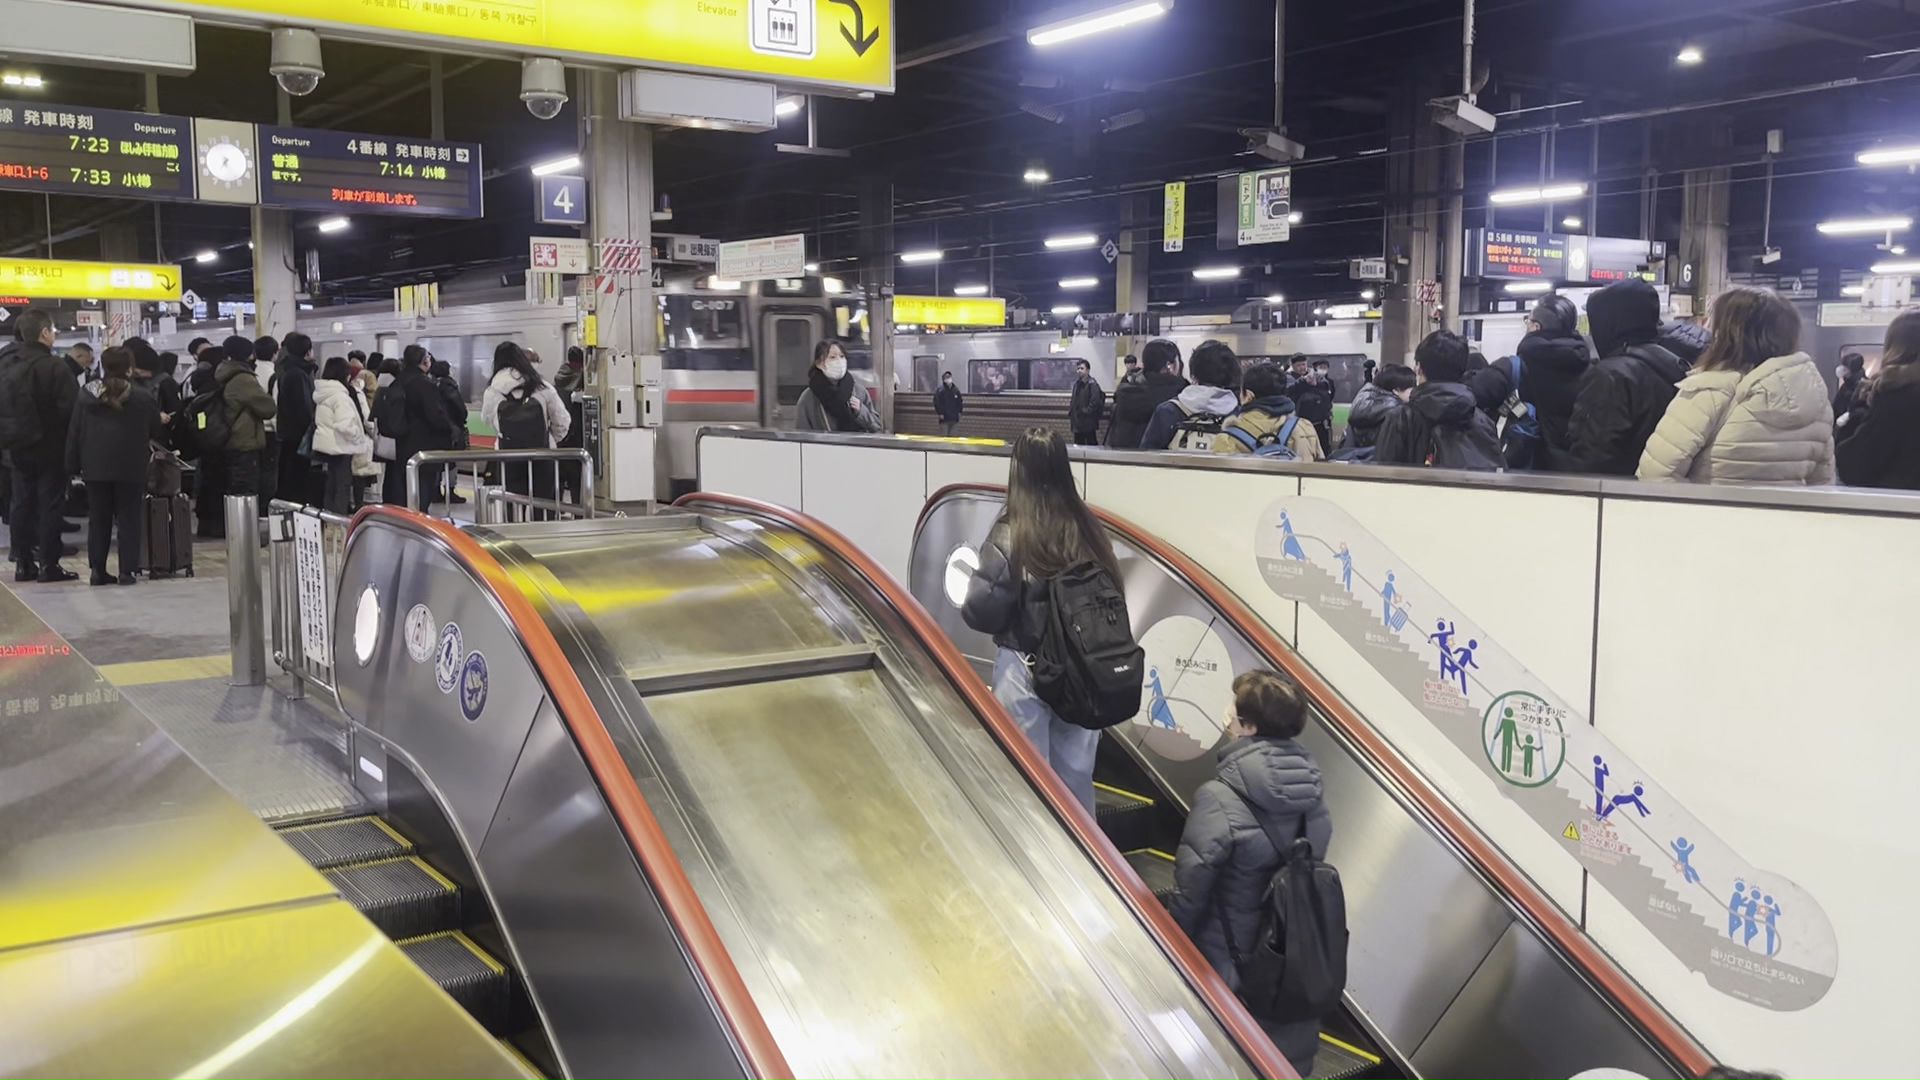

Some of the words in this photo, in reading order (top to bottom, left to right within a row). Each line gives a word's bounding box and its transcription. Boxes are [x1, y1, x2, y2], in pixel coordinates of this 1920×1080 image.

[697, 1, 737, 16] Elevator
[24, 109, 94, 131] 発車時刻
[134, 122, 177, 135] Departure
[69, 135, 109, 153] 7:23
[272, 135, 310, 147] Departure
[347, 140, 388, 156] 4番線
[396, 143, 451, 161] 発車時刻
[272, 153, 299, 169] 普通
[380, 161, 414, 177] 7:14
[70, 168, 111, 186] 7:33
[122, 172, 152, 188] 小樽
[422, 165, 446, 180] 小樽
[332, 188, 418, 206] 列車が到着します。
[553, 185, 574, 214] 4
[534, 244, 556, 252] STOP
[1105, 245, 1114, 258] 2
[14, 265, 63, 279] 東改札口
[652, 267, 662, 286] 4
[1683, 263, 1692, 282] 6
[187, 294, 194, 304] 3
[1520, 702, 1567, 719] 常に手すりに
[1520, 713, 1551, 727] つかまる
